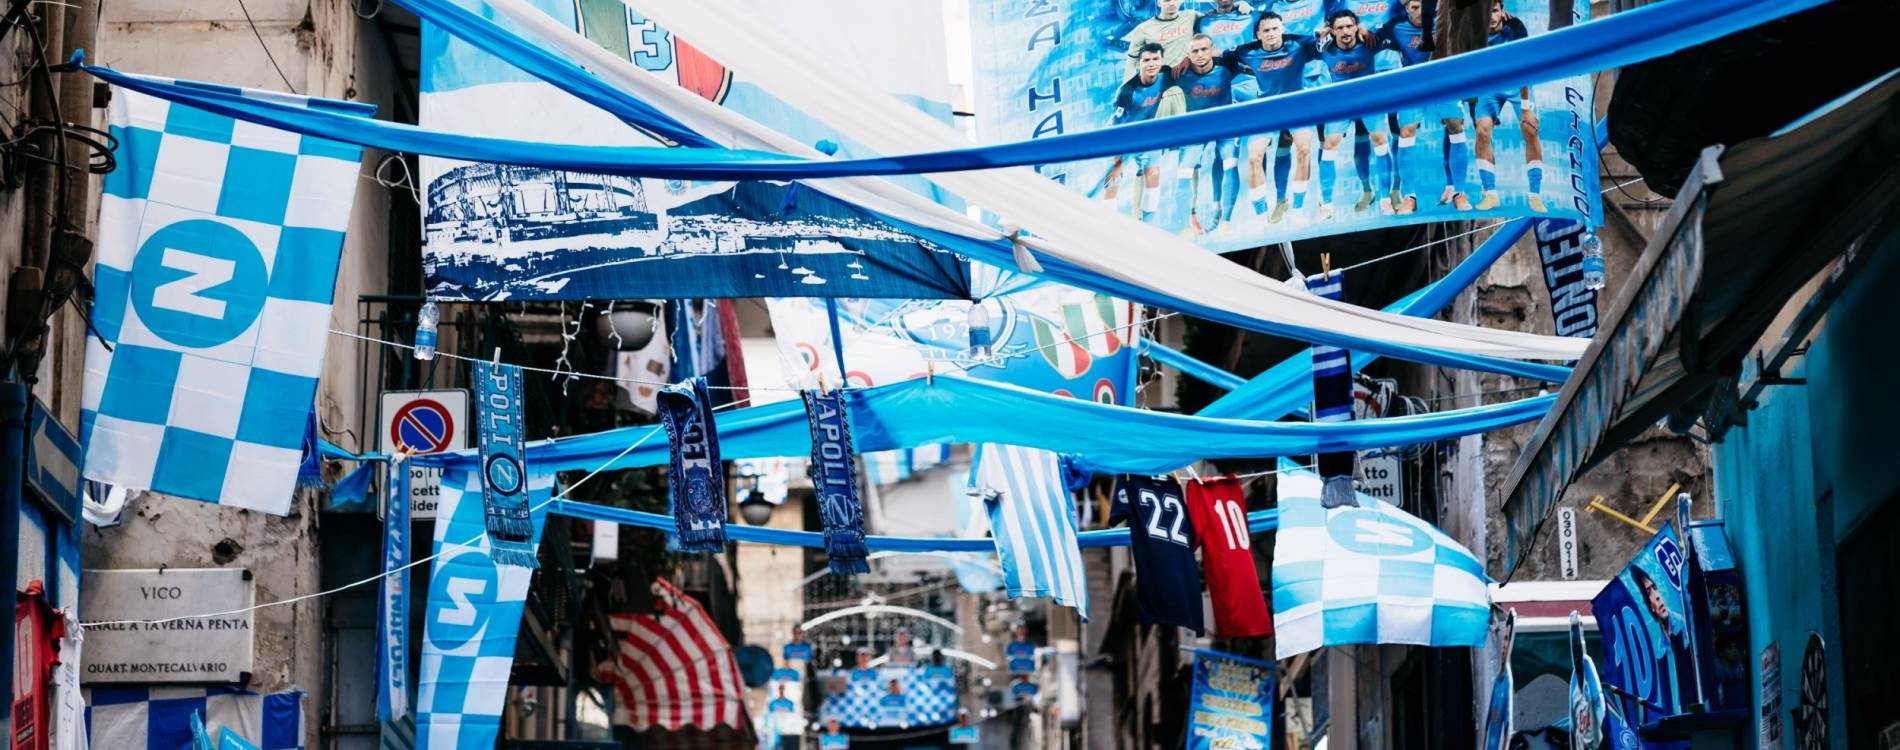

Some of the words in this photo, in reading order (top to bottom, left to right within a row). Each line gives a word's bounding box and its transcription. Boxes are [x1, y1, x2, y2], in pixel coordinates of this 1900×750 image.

[1538, 219, 1597, 338] ONTEC
[929, 322, 971, 342] 192
[1365, 466, 1388, 479] tto
[412, 485, 440, 496] cett
[1140, 488, 1190, 549] 22
[1215, 500, 1250, 550] 10
[1563, 510, 1572, 538] 030
[1564, 541, 1574, 577] 0112
[141, 587, 182, 600] VICO
[129, 619, 138, 631] A
[143, 618, 204, 631] TAVERNA
[208, 619, 249, 630] PENTA
[1611, 605, 1658, 701] 10
[88, 663, 128, 673] QUART.
[130, 662, 227, 673] MONTECALVARIO
